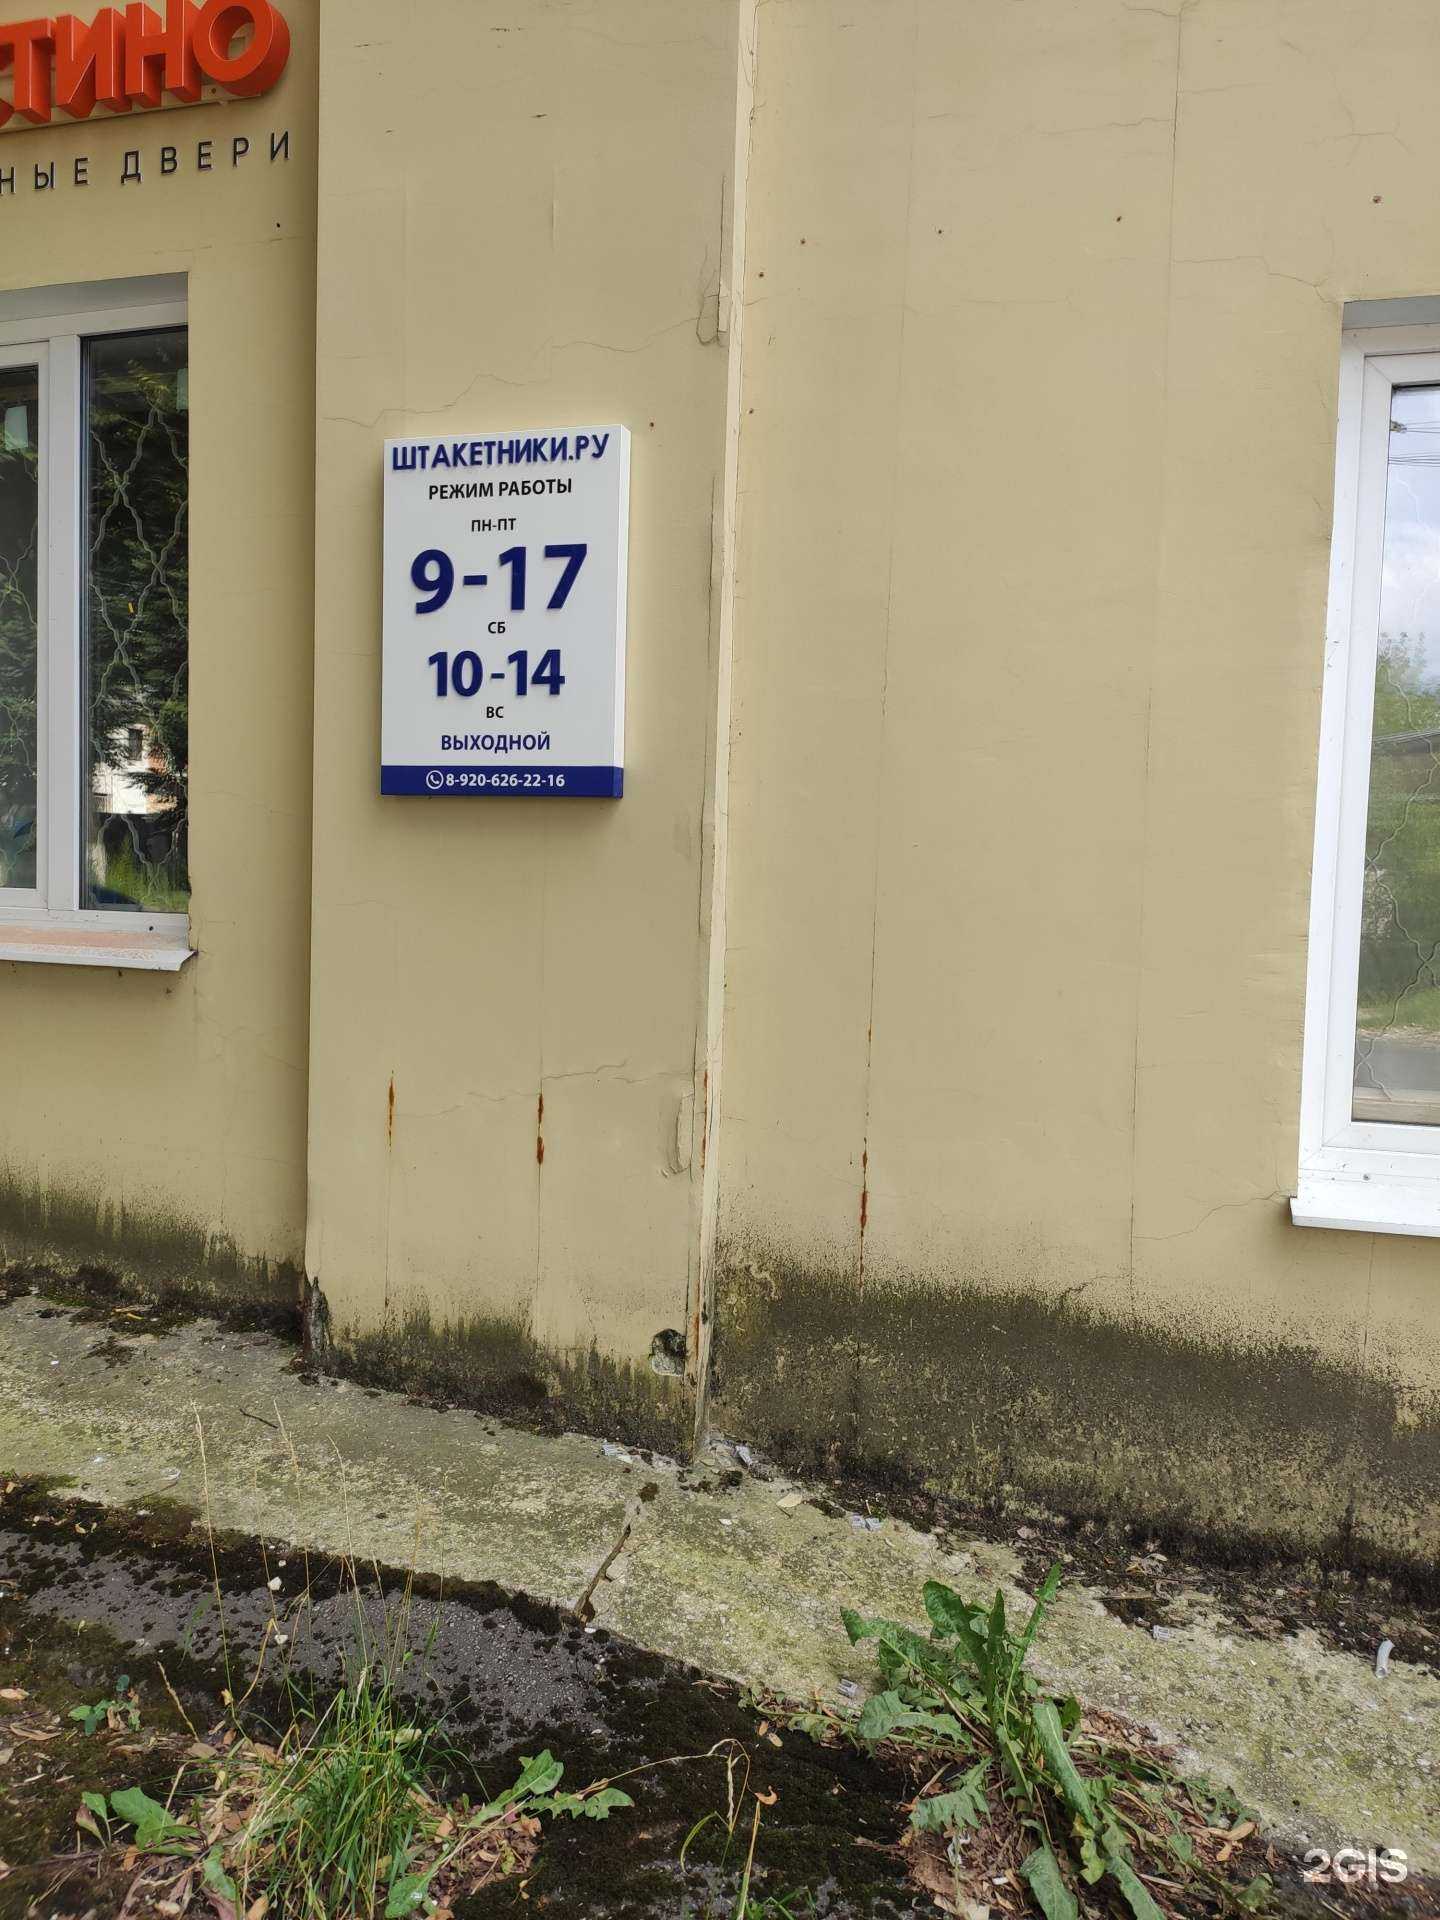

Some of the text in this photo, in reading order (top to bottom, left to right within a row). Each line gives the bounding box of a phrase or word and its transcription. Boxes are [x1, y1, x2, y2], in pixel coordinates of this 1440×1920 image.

[0, 0, 291, 129] ТИНО
[0, 130, 290, 195] НЫЕ ДВЕРИ
[392, 433, 610, 471] ШТАКЕТНИКИ.РУ
[428, 478, 572, 500] РЕЖИМ РАБОТЫ
[471, 517, 517, 532] ПН-ПТ
[410, 543, 588, 615] 9-17
[487, 621, 507, 634] СБ
[428, 649, 566, 698] 10-14
[485, 706, 505, 719] ВС
[441, 731, 551, 754] ВЫХОДНОЙ
[445, 773, 566, 788] 8-920-626-22-16
